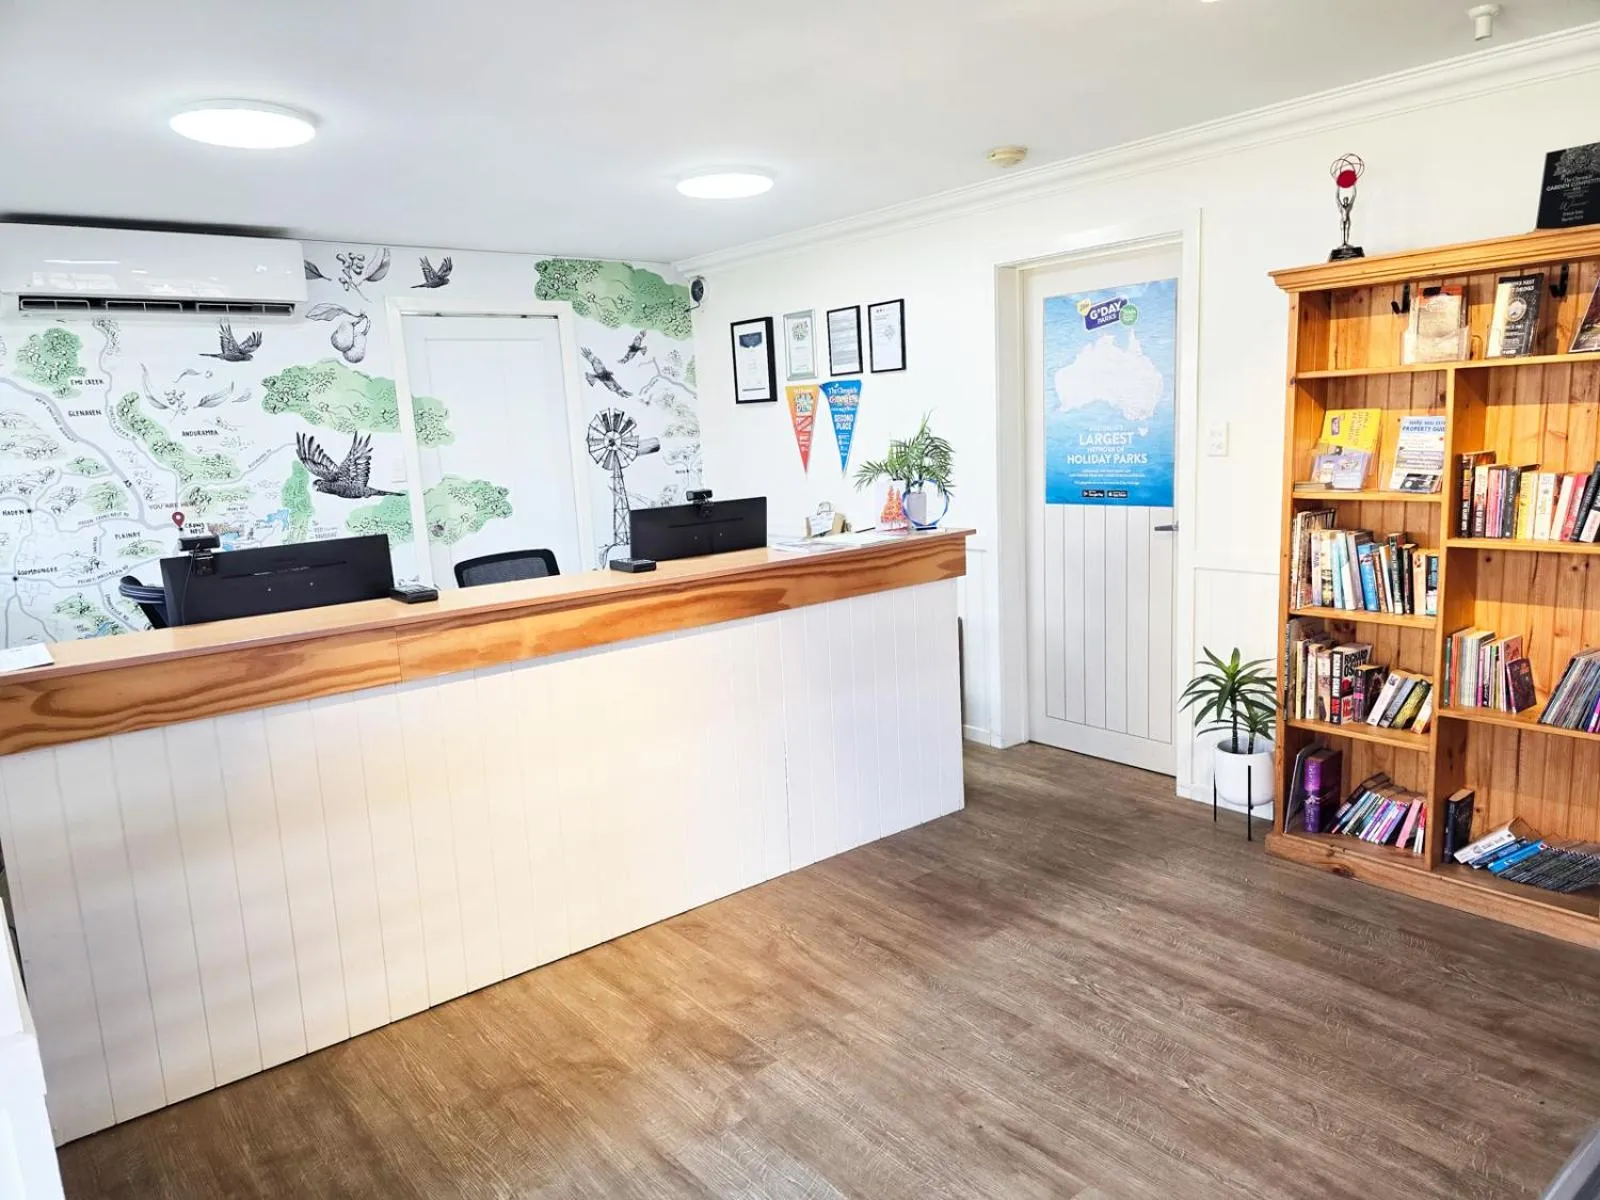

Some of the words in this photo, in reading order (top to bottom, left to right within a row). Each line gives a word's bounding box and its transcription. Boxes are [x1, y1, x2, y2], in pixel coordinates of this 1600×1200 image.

[1090, 301, 1122, 320] G'DAY
[1097, 314, 1117, 325] PARKS
[833, 413, 854, 423] SECOND
[835, 422, 852, 430] PLACE
[1079, 432, 1135, 446] LARGEST
[1067, 454, 1112, 465] HOLIDAY
[1113, 452, 1148, 464] PARKS
[149, 502, 164, 511] YOU
